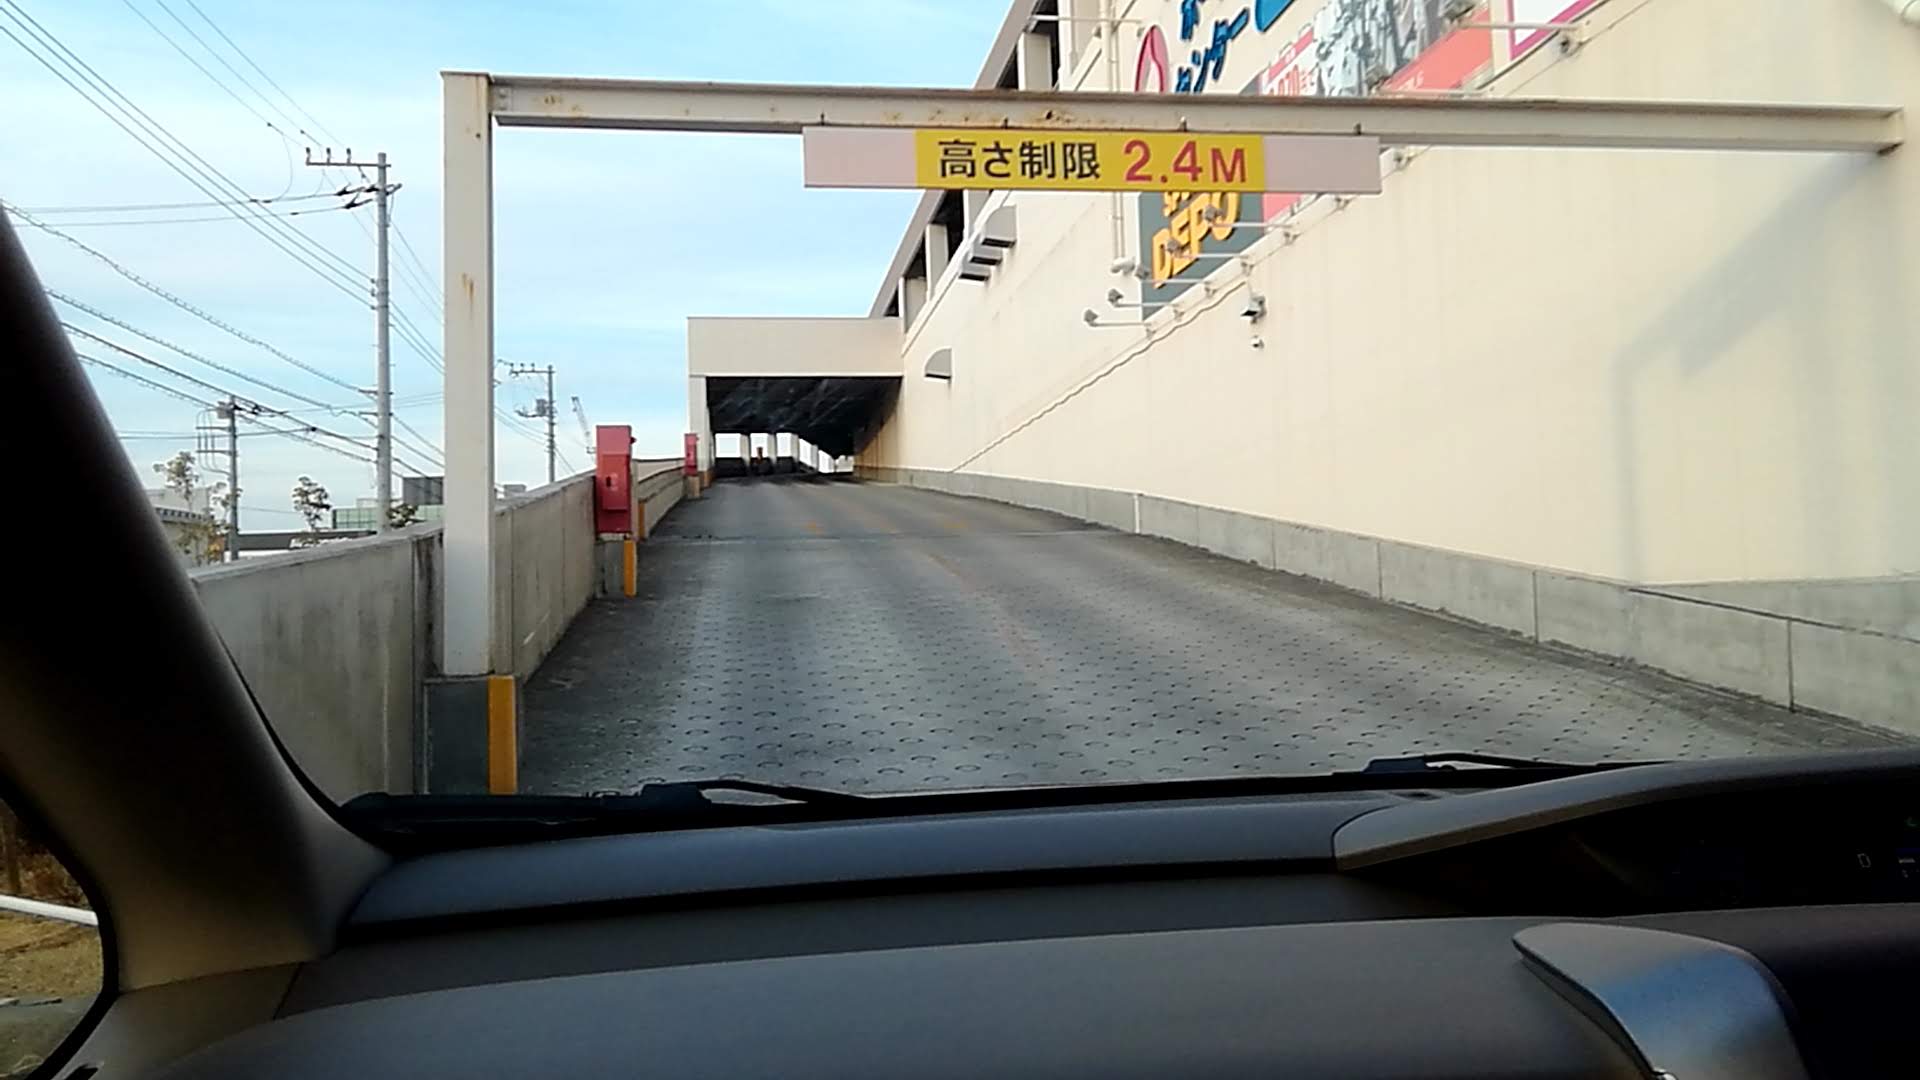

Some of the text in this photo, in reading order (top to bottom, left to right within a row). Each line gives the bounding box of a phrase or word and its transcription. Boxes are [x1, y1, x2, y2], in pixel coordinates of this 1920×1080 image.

[938, 140, 1246, 183] 高さ制限 2.4M
[1152, 192, 1239, 289] DEPO
